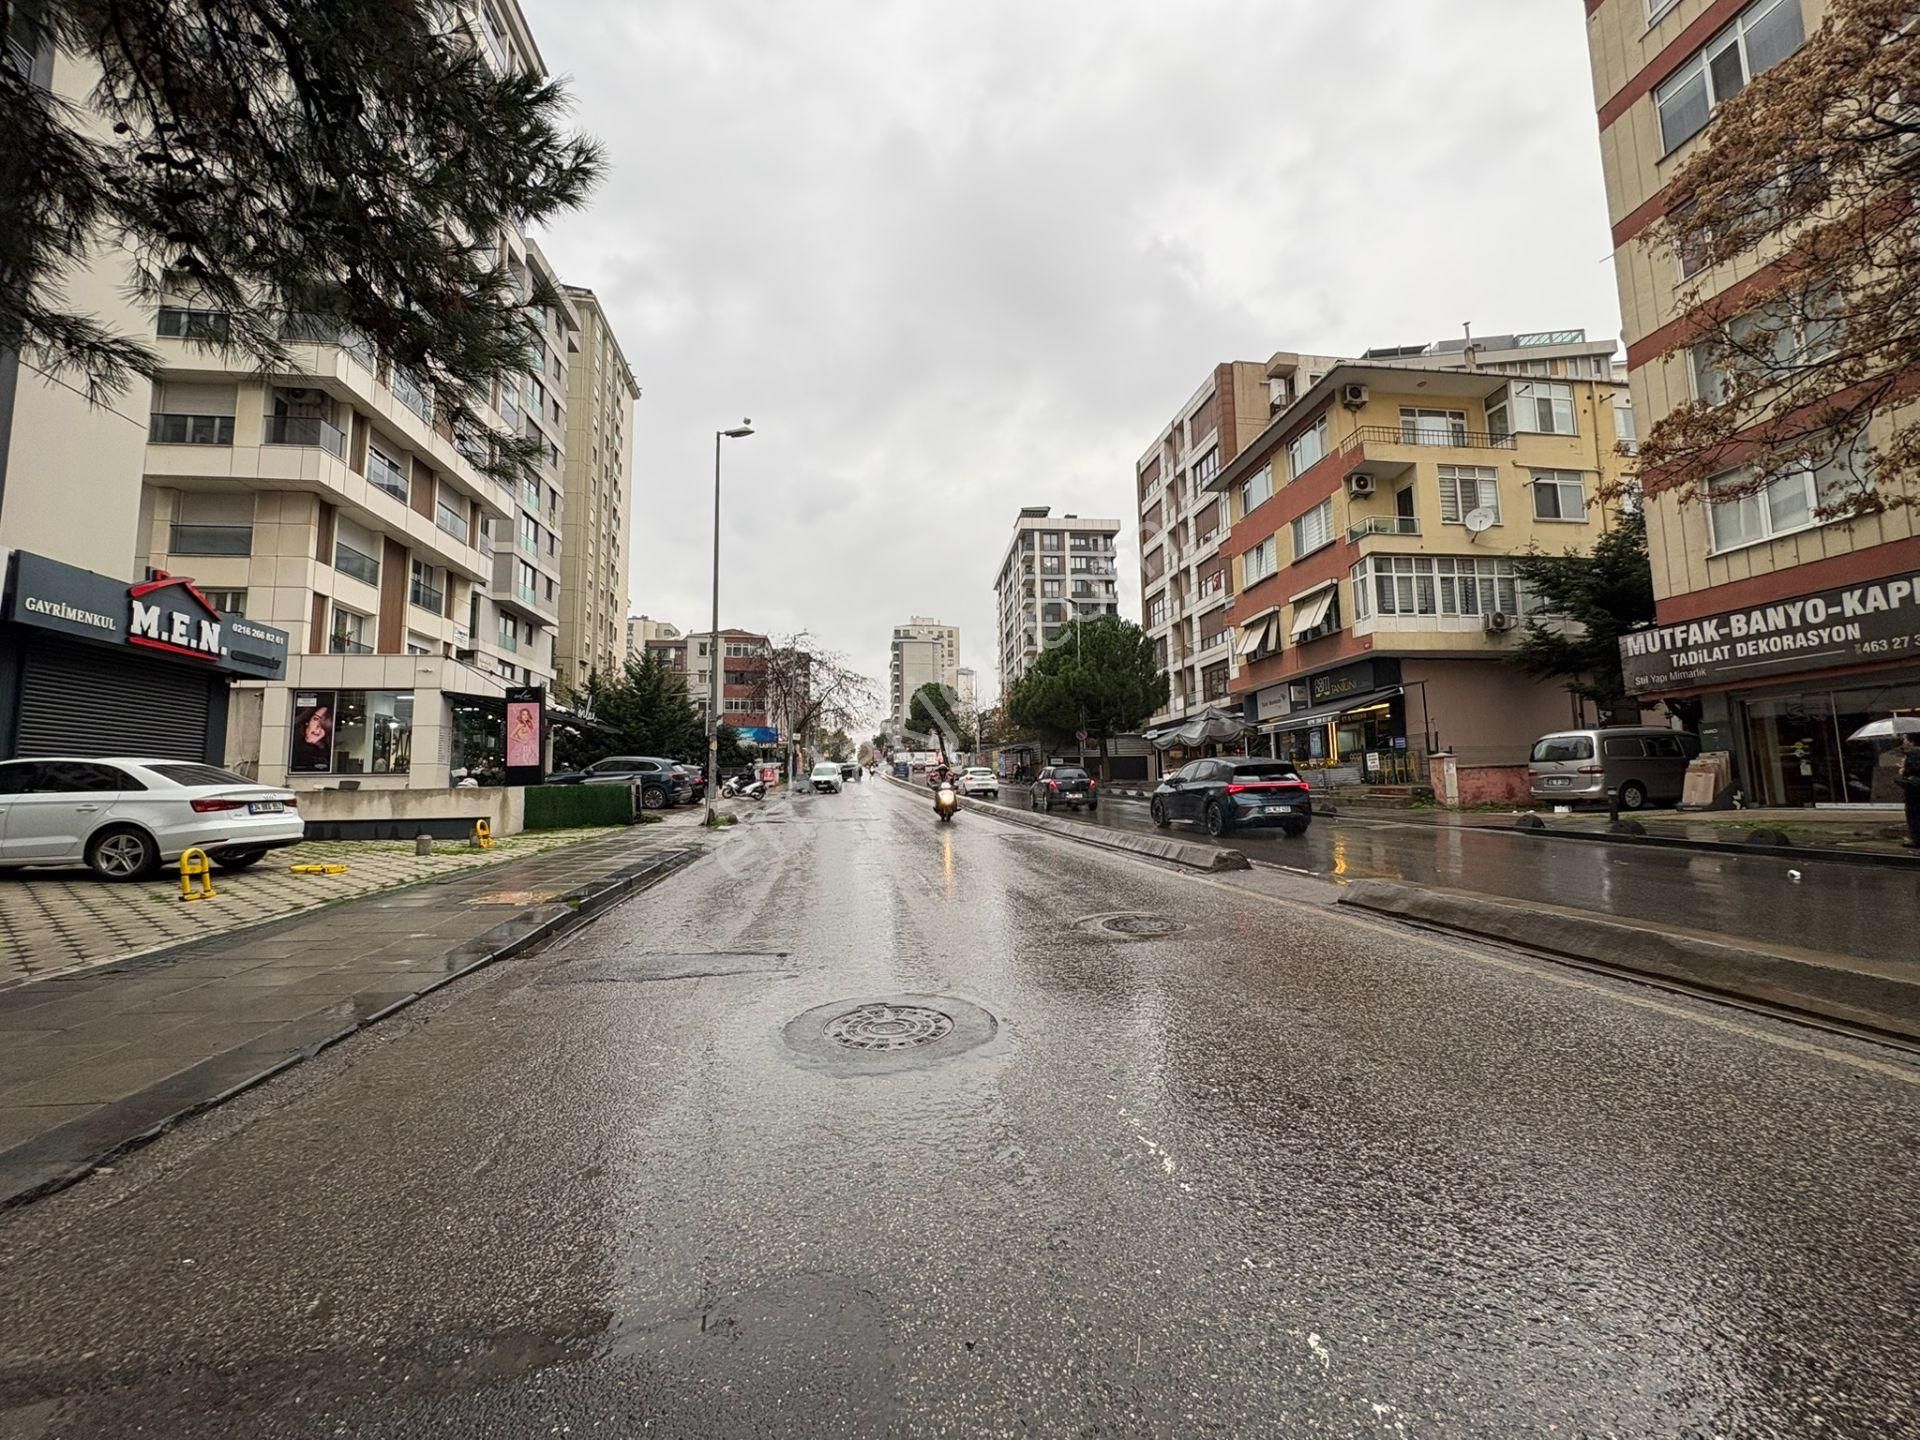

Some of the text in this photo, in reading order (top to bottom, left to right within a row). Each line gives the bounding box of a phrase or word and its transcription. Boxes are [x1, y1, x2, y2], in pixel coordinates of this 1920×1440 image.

[25, 597, 117, 631] GAYRİMENKUL
[1735, 622, 1861, 658] DEKORASYON
[1862, 639, 1889, 654] 463
[1891, 636, 1910, 650] 27
